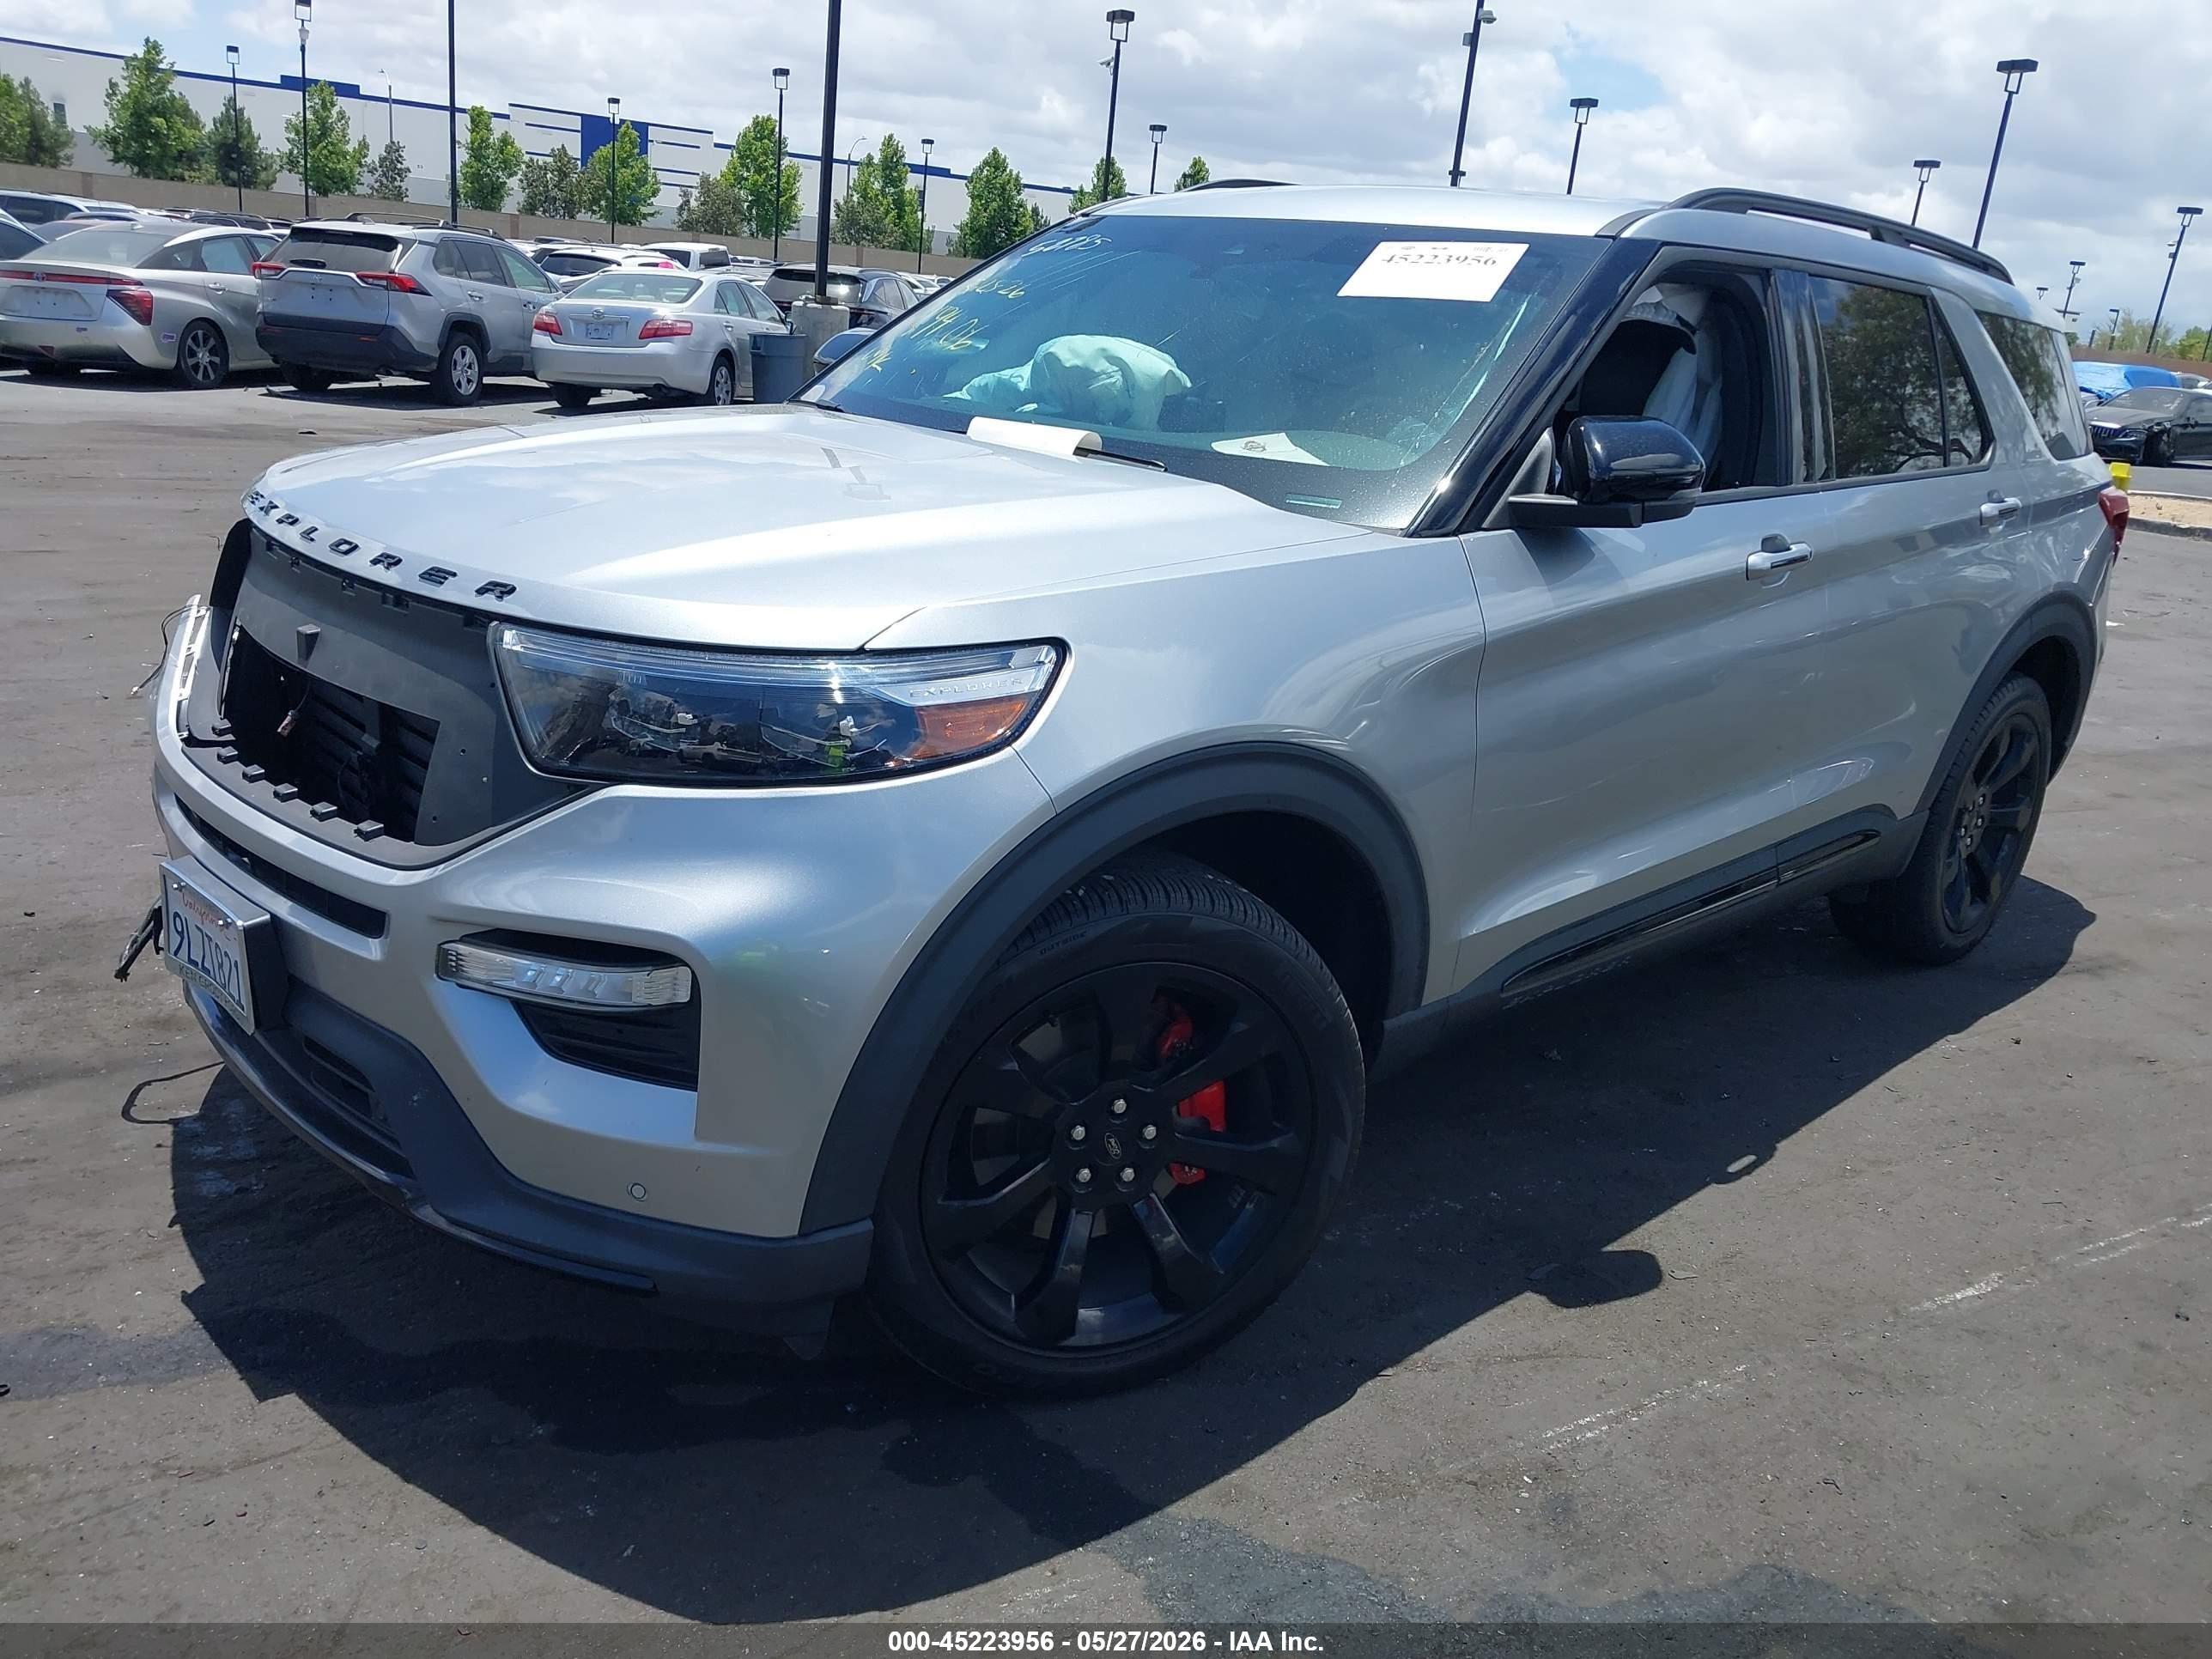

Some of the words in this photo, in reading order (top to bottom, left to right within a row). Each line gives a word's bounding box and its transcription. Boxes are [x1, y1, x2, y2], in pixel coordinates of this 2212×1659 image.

[1382, 254, 1497, 265] 45223956
[247, 489, 518, 601] EXPLORER
[908, 678, 1024, 698] EXPLORER
[173, 911, 246, 1012] 9LZT821
